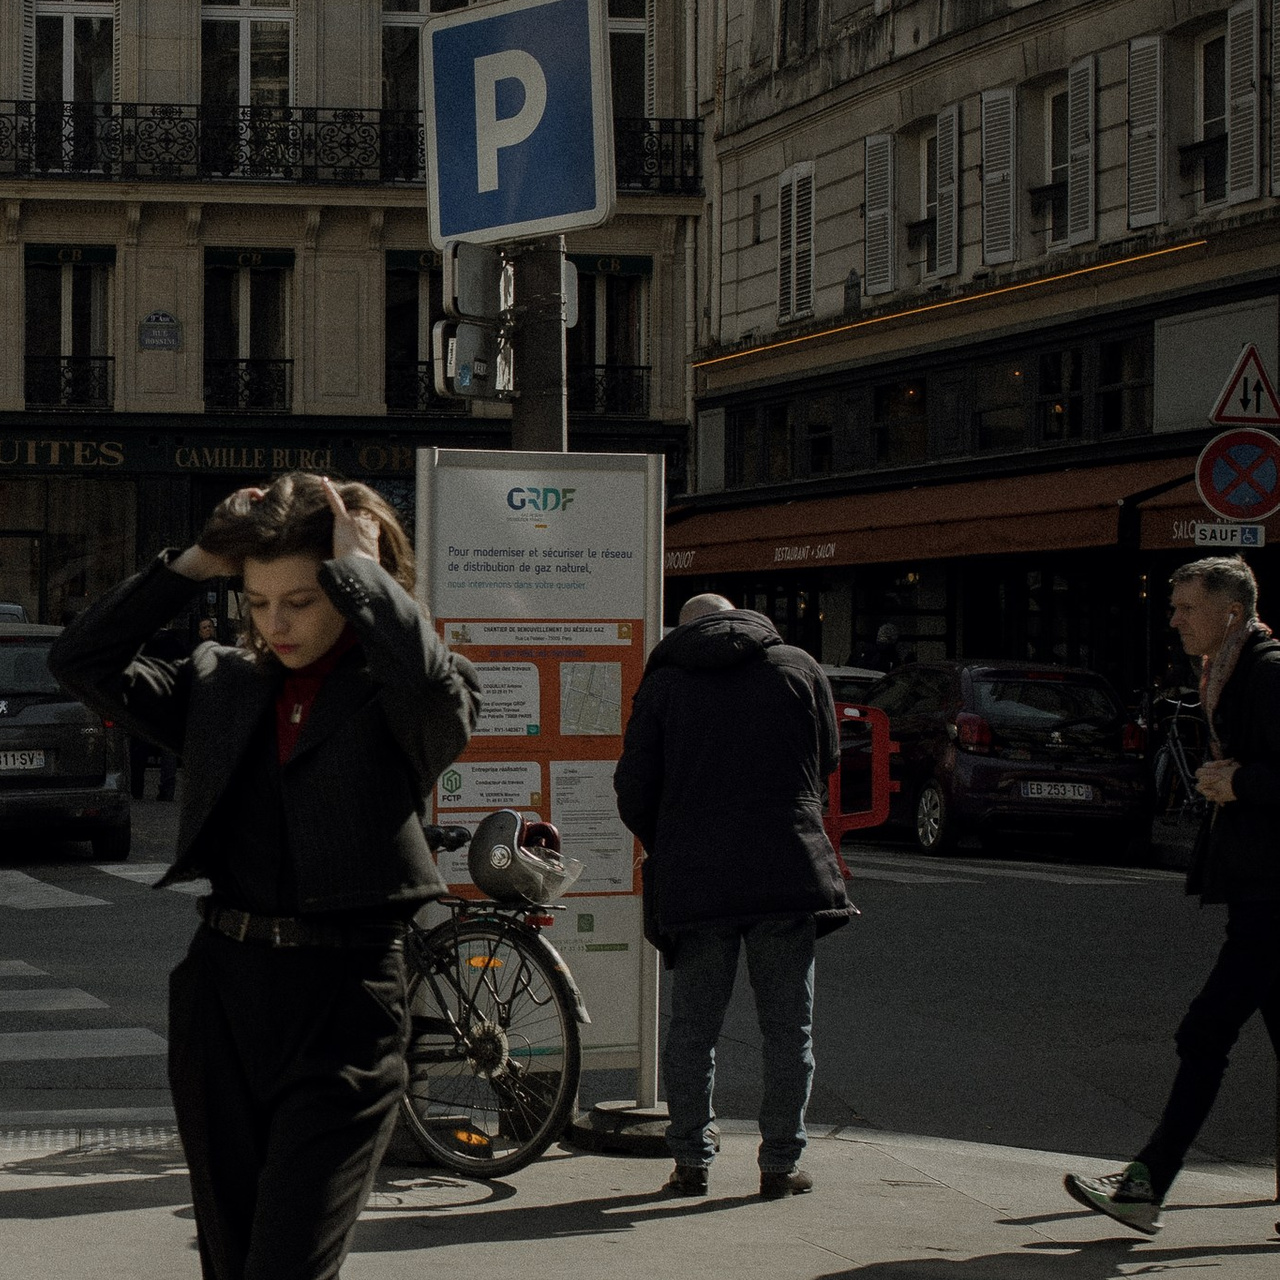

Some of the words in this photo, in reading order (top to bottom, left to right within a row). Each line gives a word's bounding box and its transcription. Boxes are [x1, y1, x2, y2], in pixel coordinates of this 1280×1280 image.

[474, 49, 547, 195] P
[58, 249, 82, 262] CB
[239, 253, 262, 266] CB
[175, 446, 266, 469] CAMILLE
[507, 487, 577, 511] GRDF
[1199, 528, 1238, 541] SAUF
[448, 546, 470, 558] Pour
[473, 546, 525, 558] moderniser
[529, 548, 539, 558] et
[542, 547, 584, 559] sécuriser
[588, 548, 597, 558] le
[601, 549, 633, 559] réseau
[774, 546, 811, 562] RESTAURANT
[447, 562, 459, 572] de
[463, 562, 515, 572] distribution
[520, 563, 531, 572] de
[534, 564, 551, 575] gaz
[515, 580, 533, 589] dans
[1030, 783, 1084, 797] EB-253-TC
[442, 794, 462, 802] FCTP
